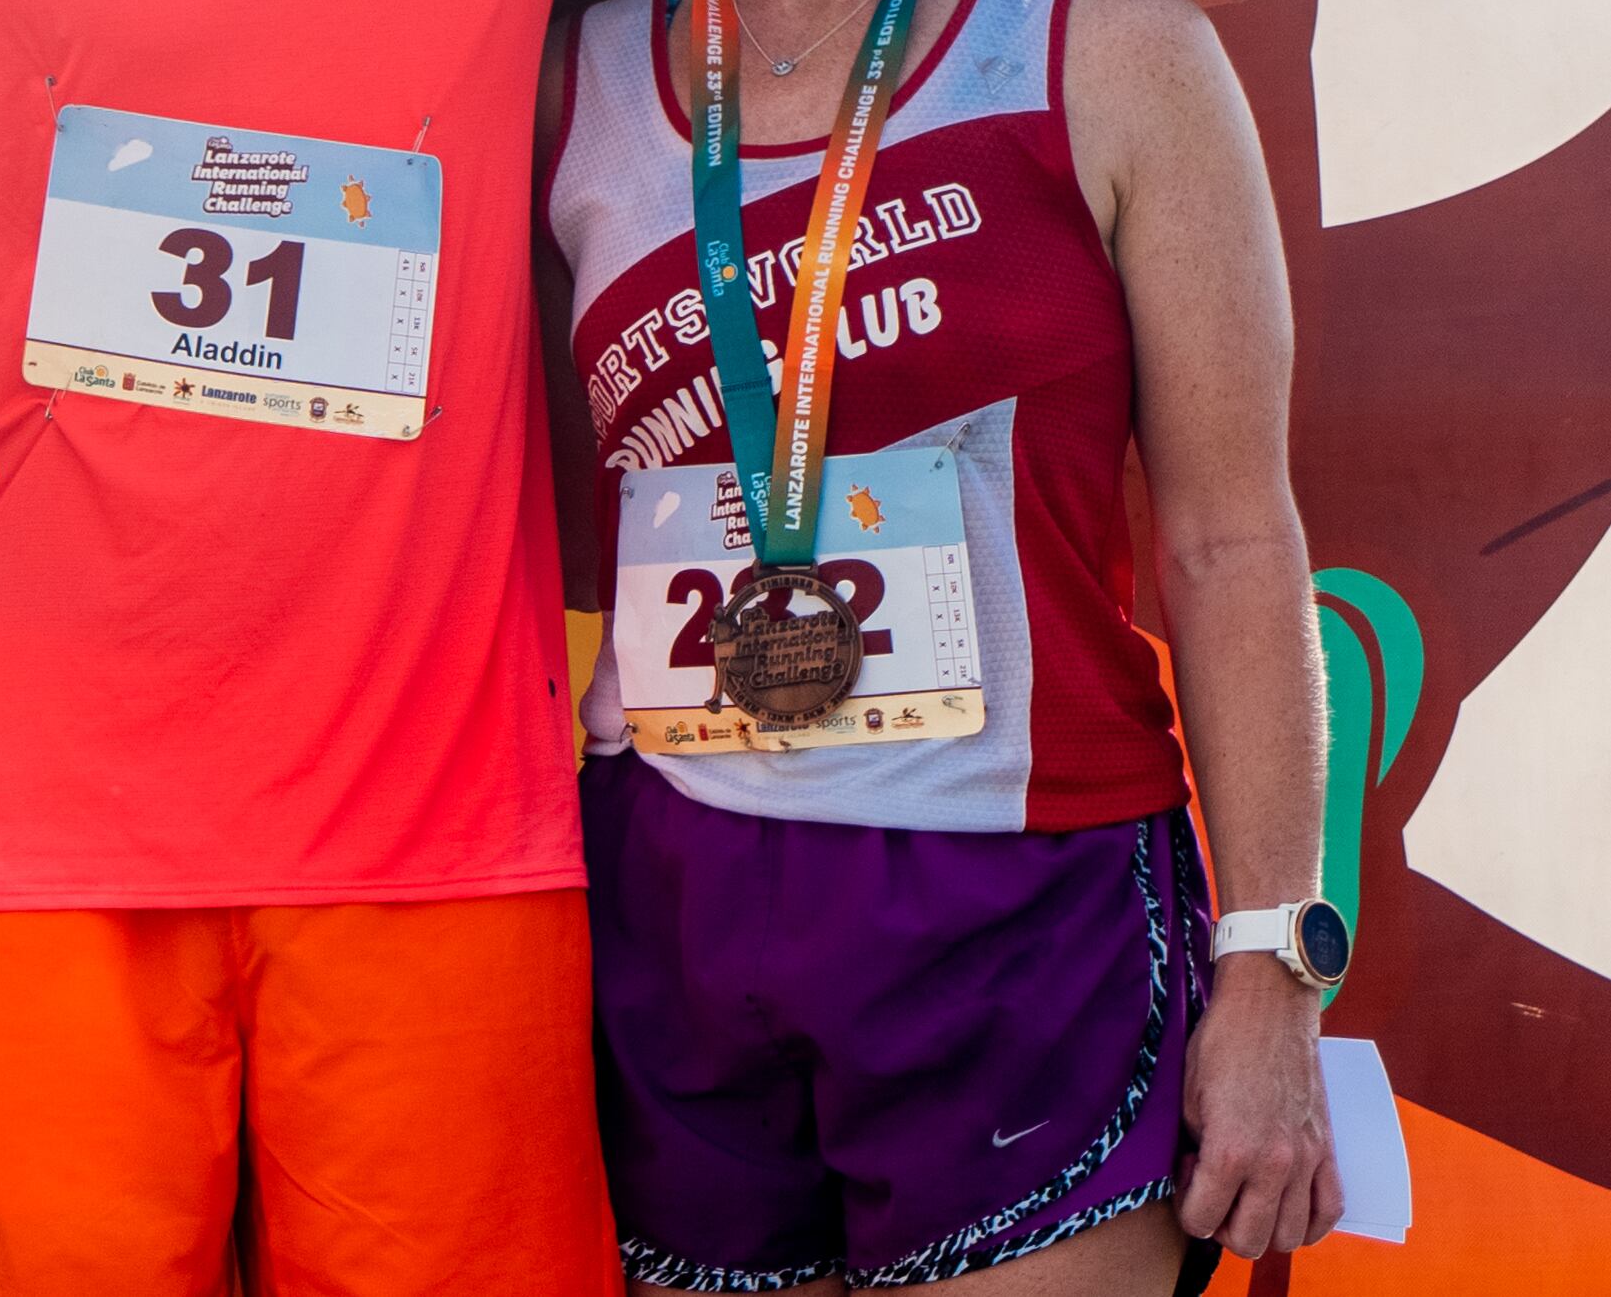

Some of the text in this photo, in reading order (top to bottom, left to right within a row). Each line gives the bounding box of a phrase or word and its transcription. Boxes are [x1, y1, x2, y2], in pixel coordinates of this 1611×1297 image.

[707, 103, 722, 167] EDITION
[838, 85, 877, 182] CHALLENGE
[205, 149, 296, 164] Lanzarote
[193, 165, 308, 180] International
[211, 180, 289, 199] Running
[204, 197, 293, 216] Challenge
[818, 182, 850, 266] RUNNING
[151, 227, 305, 341] 31
[171, 332, 283, 370] Aladdin
[794, 267, 831, 416] INTERNATIONAL
[201, 384, 257, 405] Lanzarote
[263, 396, 302, 412] sports
[785, 418, 810, 530] LANZAROTE
[760, 575, 814, 589] FINISHER
[744, 611, 840, 635] Lanzarote
[758, 647, 836, 668] Running
[750, 662, 845, 688] Challenge
[816, 715, 857, 731] sports
